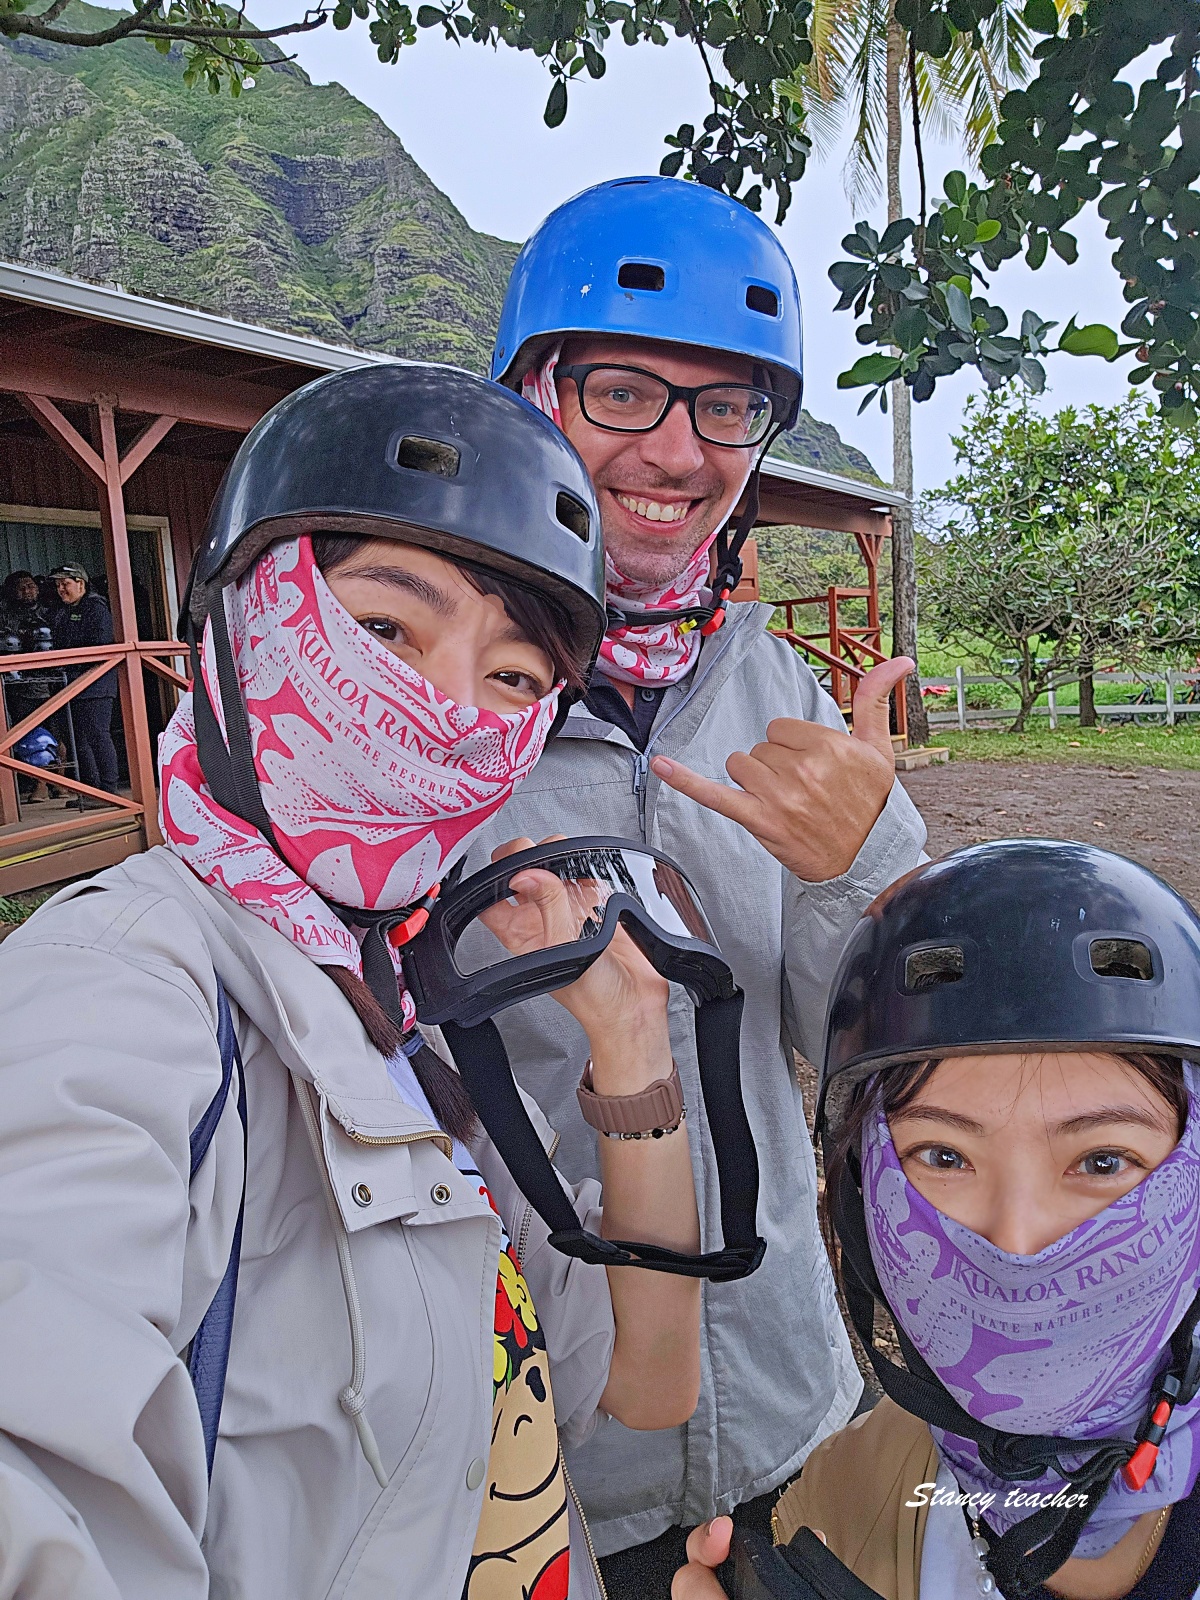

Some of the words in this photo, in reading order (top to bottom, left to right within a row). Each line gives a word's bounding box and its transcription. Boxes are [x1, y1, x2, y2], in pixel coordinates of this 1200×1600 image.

[278, 645, 320, 708] PRIVATE
[324, 710, 381, 761] NATURE
[388, 761, 455, 798] RESERVE
[295, 615, 370, 718] KUALOA
[374, 708, 465, 770] RANCH
[291, 921, 352, 954] RANCH
[949, 1296, 1020, 1333] PRIVATE
[1033, 1302, 1103, 1333] NATURE
[1115, 1246, 1180, 1304] RESERVE
[951, 1256, 1068, 1303] KUALOA
[1074, 1213, 1174, 1292] RANCH
